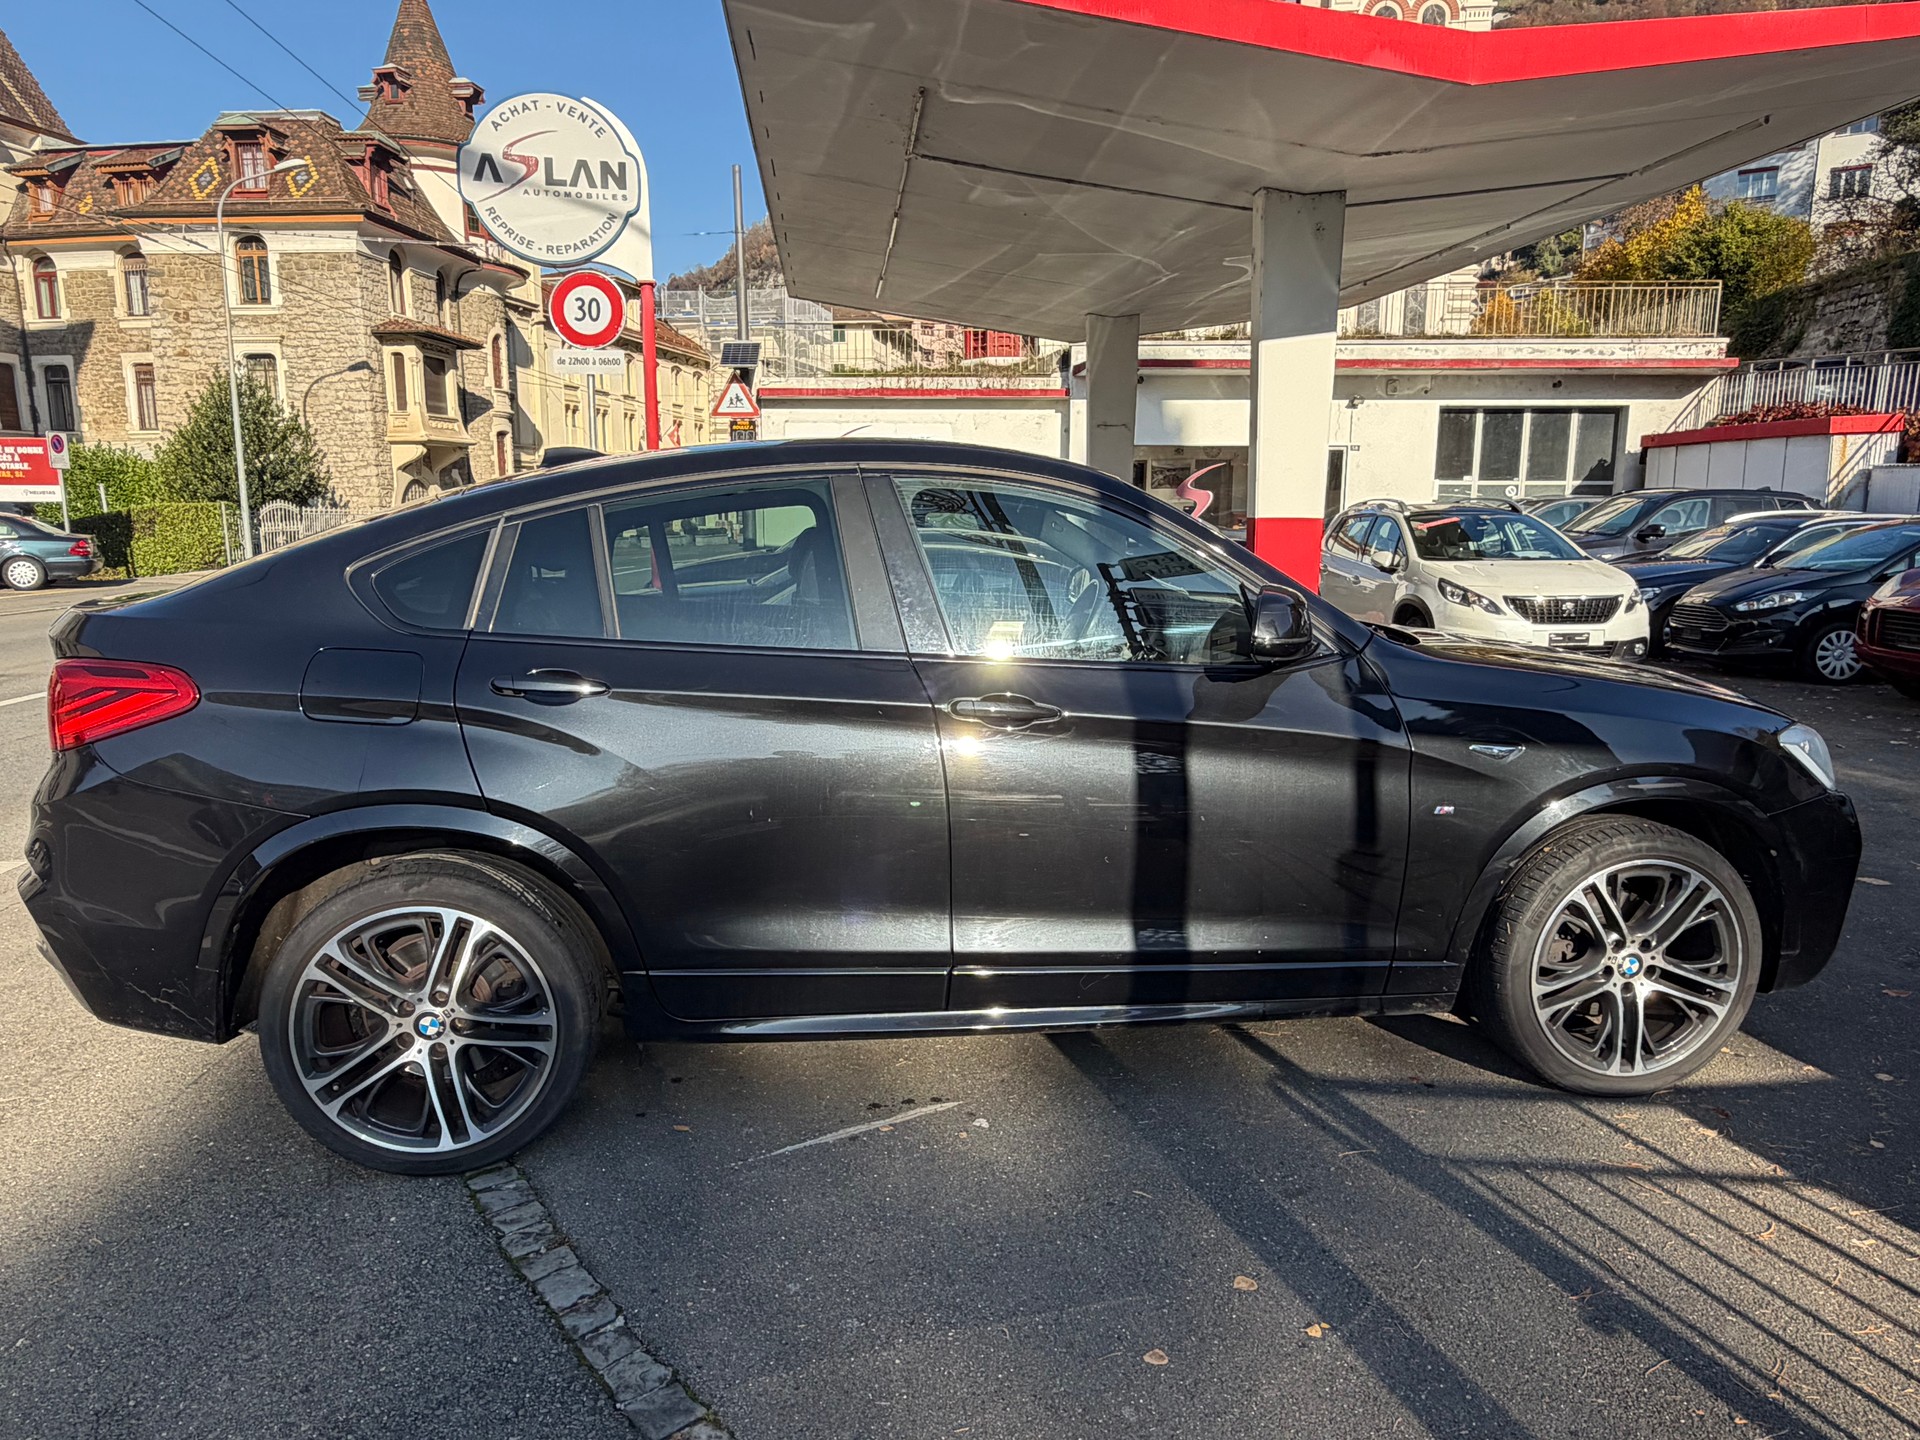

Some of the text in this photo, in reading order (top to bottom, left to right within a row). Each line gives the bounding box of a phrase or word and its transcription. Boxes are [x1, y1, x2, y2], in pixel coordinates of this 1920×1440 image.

[491, 100, 539, 132] ACHAT
[557, 101, 607, 139] VENTE
[473, 130, 628, 202] ASLAN
[523, 189, 628, 201] AUTOMOBILES
[485, 206, 535, 250] REPRISE
[546, 212, 618, 255] REPARATION
[574, 297, 601, 322] 30
[557, 356, 621, 366] de 22h00 à 06h00
